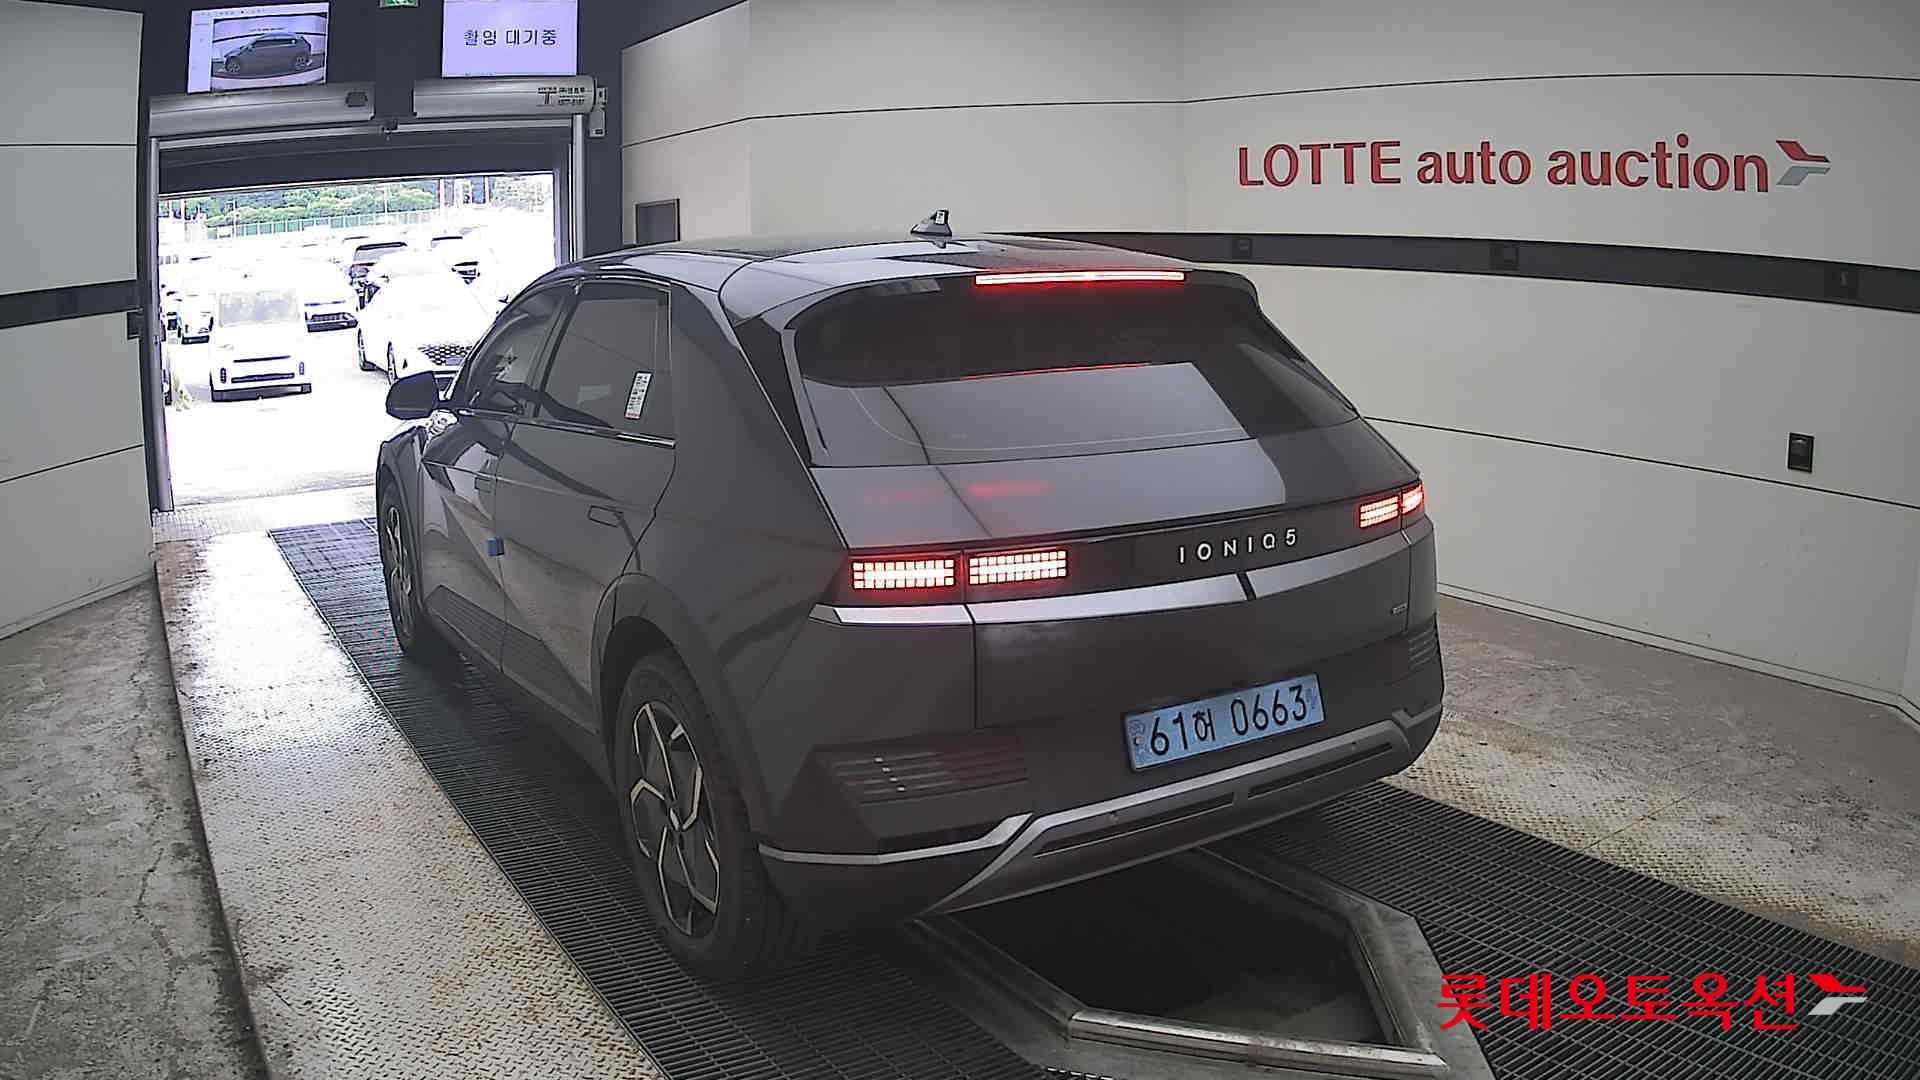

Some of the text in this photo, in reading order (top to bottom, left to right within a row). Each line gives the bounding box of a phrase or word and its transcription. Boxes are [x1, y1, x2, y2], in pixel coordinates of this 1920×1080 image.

[505, 29, 557, 46] 대기중
[1238, 134, 1770, 192] LOTTE auto auction
[1150, 685, 1308, 756] 61허 0663
